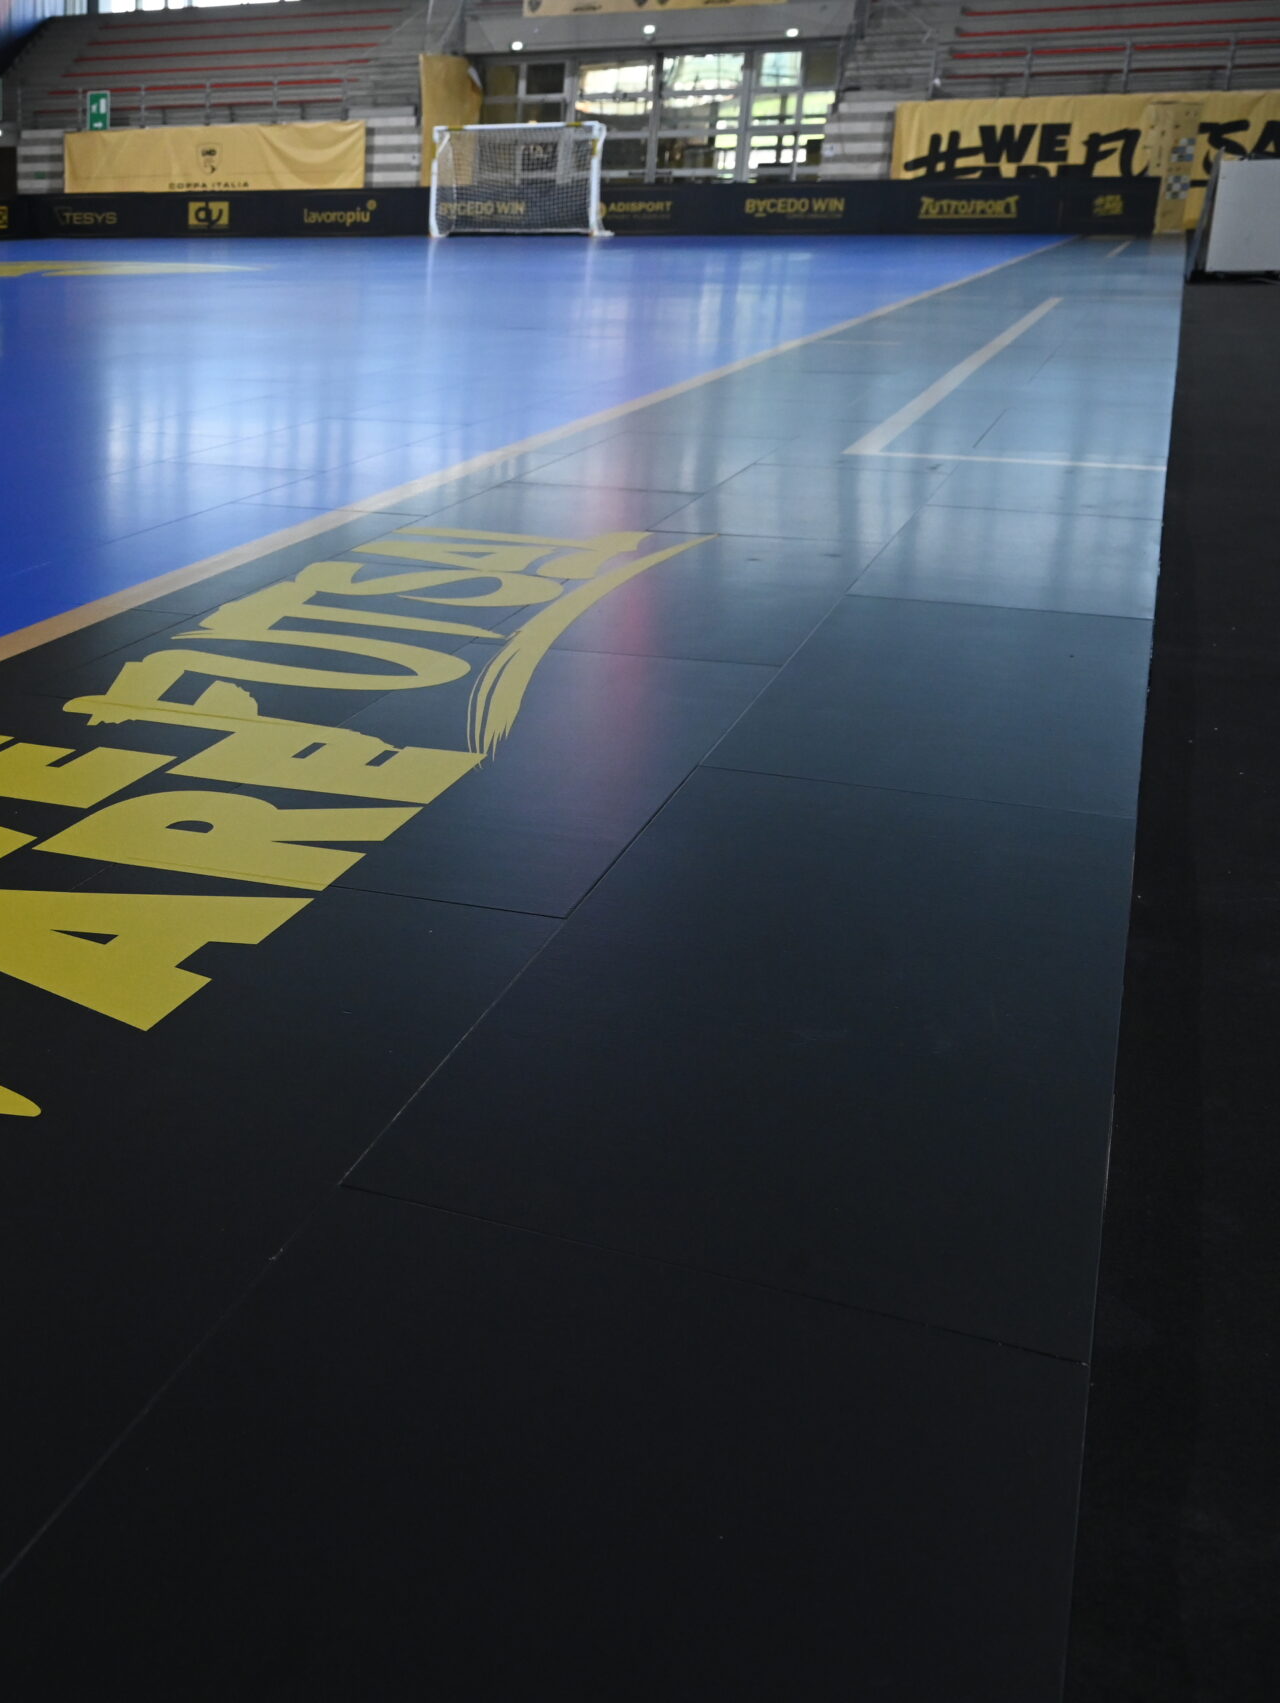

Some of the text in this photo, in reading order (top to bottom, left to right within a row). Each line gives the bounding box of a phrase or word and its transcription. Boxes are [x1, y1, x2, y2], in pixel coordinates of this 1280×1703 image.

[169, 181, 250, 190] COPPA ITALIA
[745, 197, 845, 214] BYCEDO WIN
[63, 212, 118, 225] TESYS
[63, 526, 652, 750] FUTSAL
